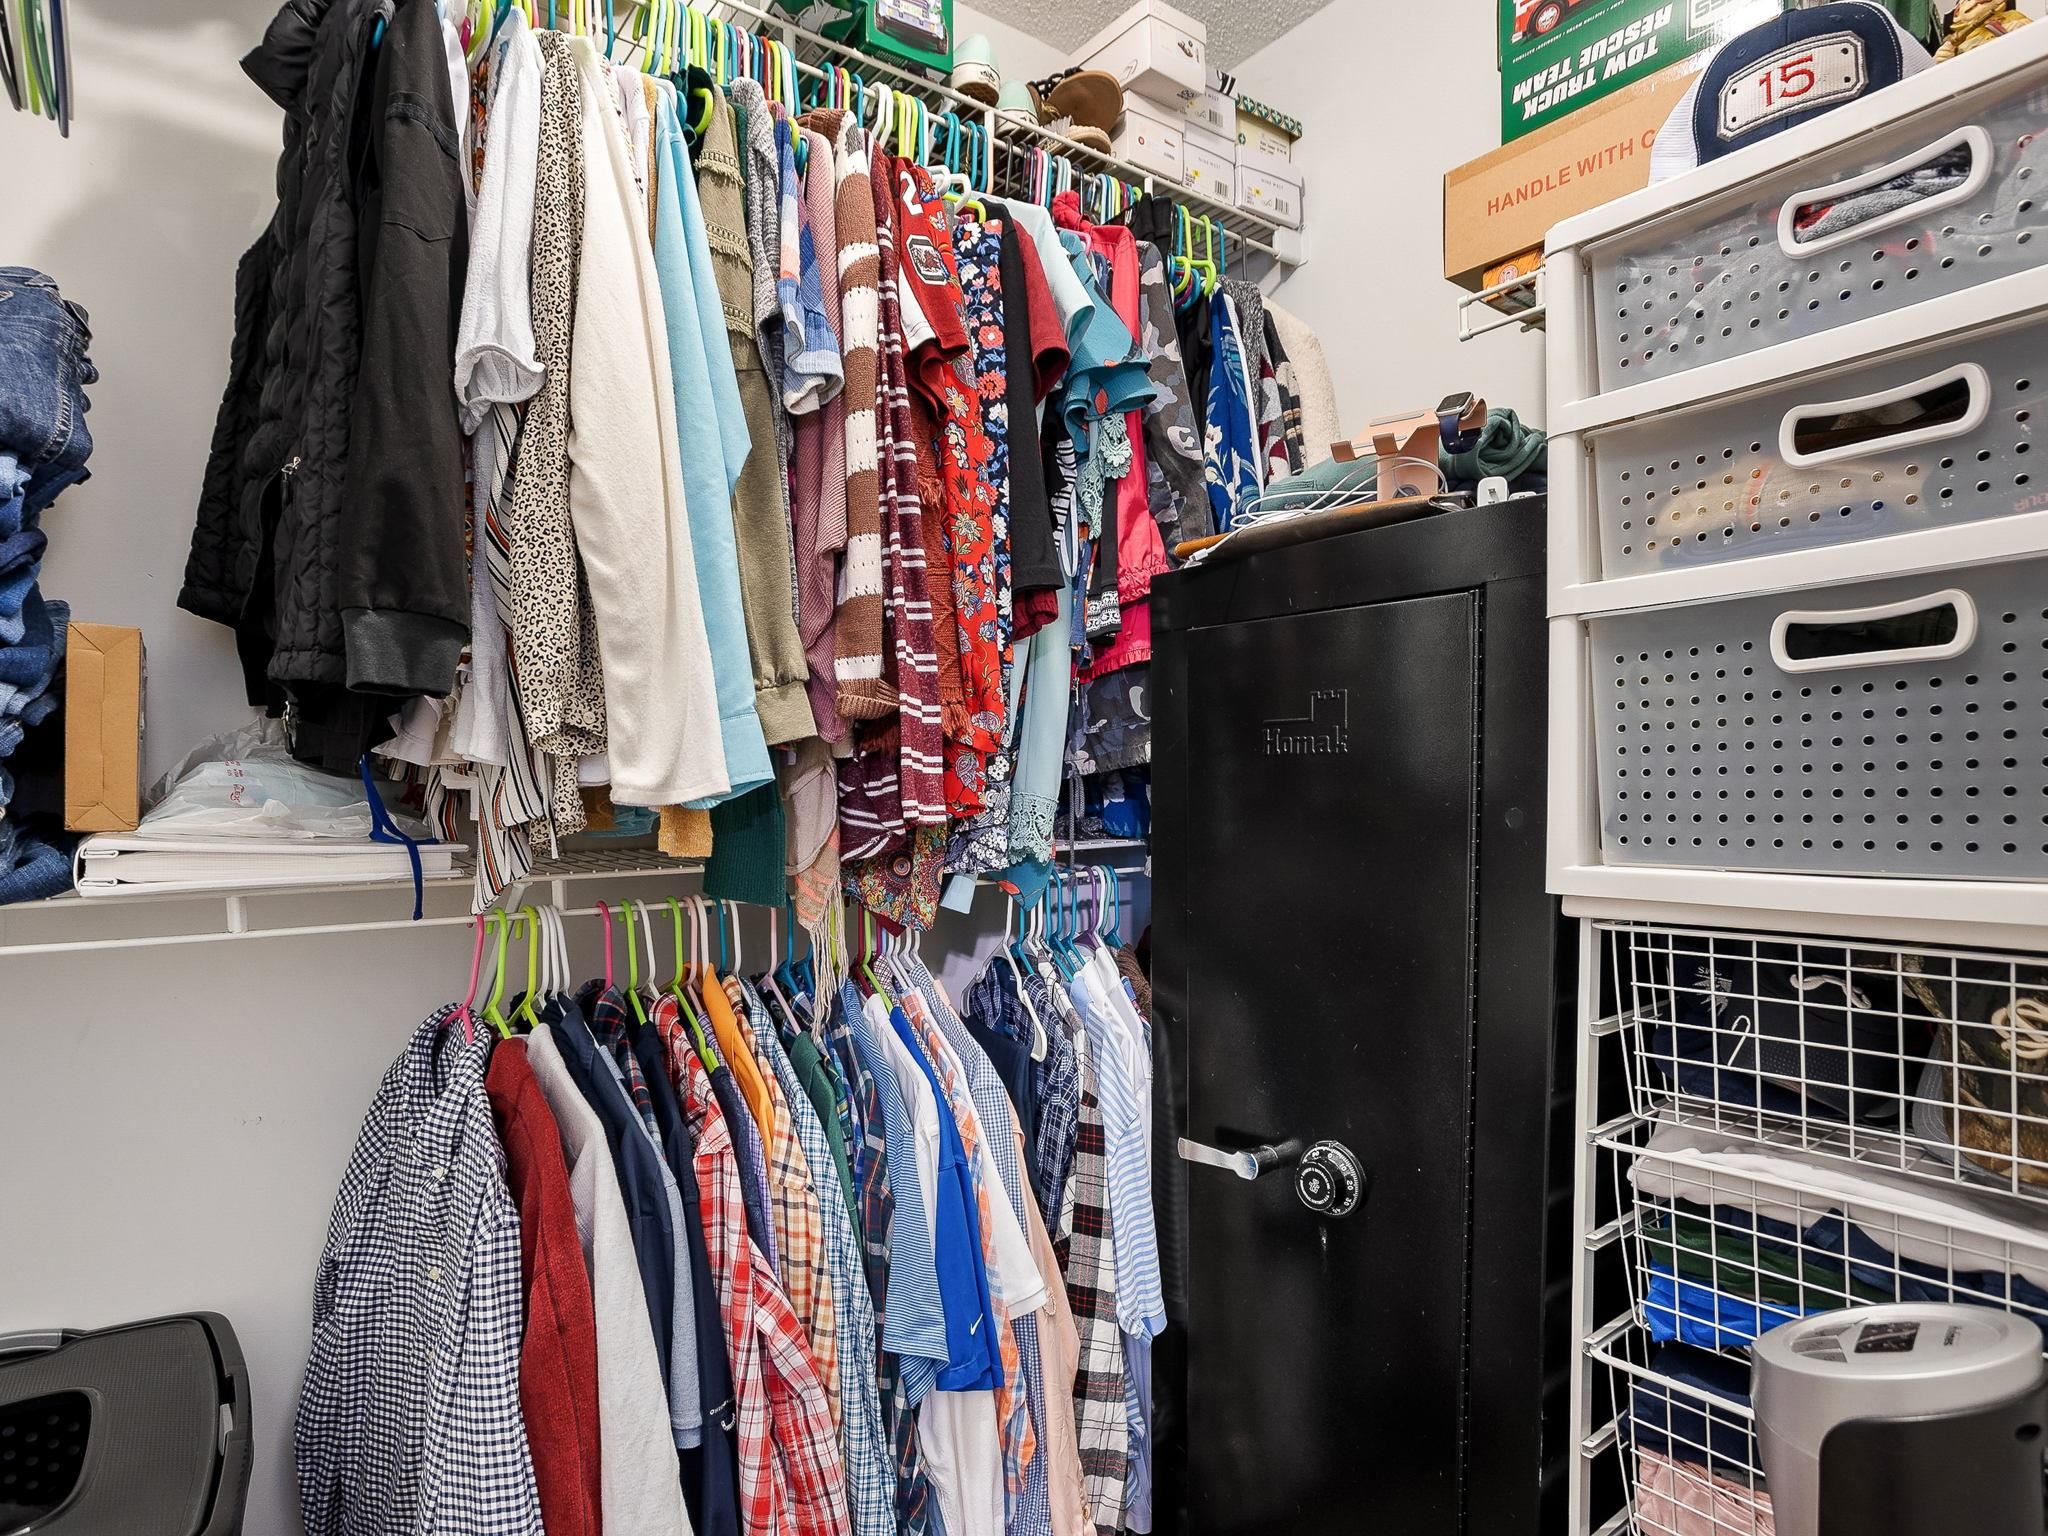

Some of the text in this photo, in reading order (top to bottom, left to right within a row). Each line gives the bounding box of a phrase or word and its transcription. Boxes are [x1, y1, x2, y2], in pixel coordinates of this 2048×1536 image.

[1512, 2, 1673, 105] RESCUE TEAM
[1522, 34, 1659, 121] TOW TRUCK
[1759, 54, 1815, 107] 15
[1487, 165, 1571, 217] HANDLE
[1576, 137, 1634, 177] WITH
[1262, 725, 1348, 755] Homak
[1346, 1180, 1355, 1191] 20
